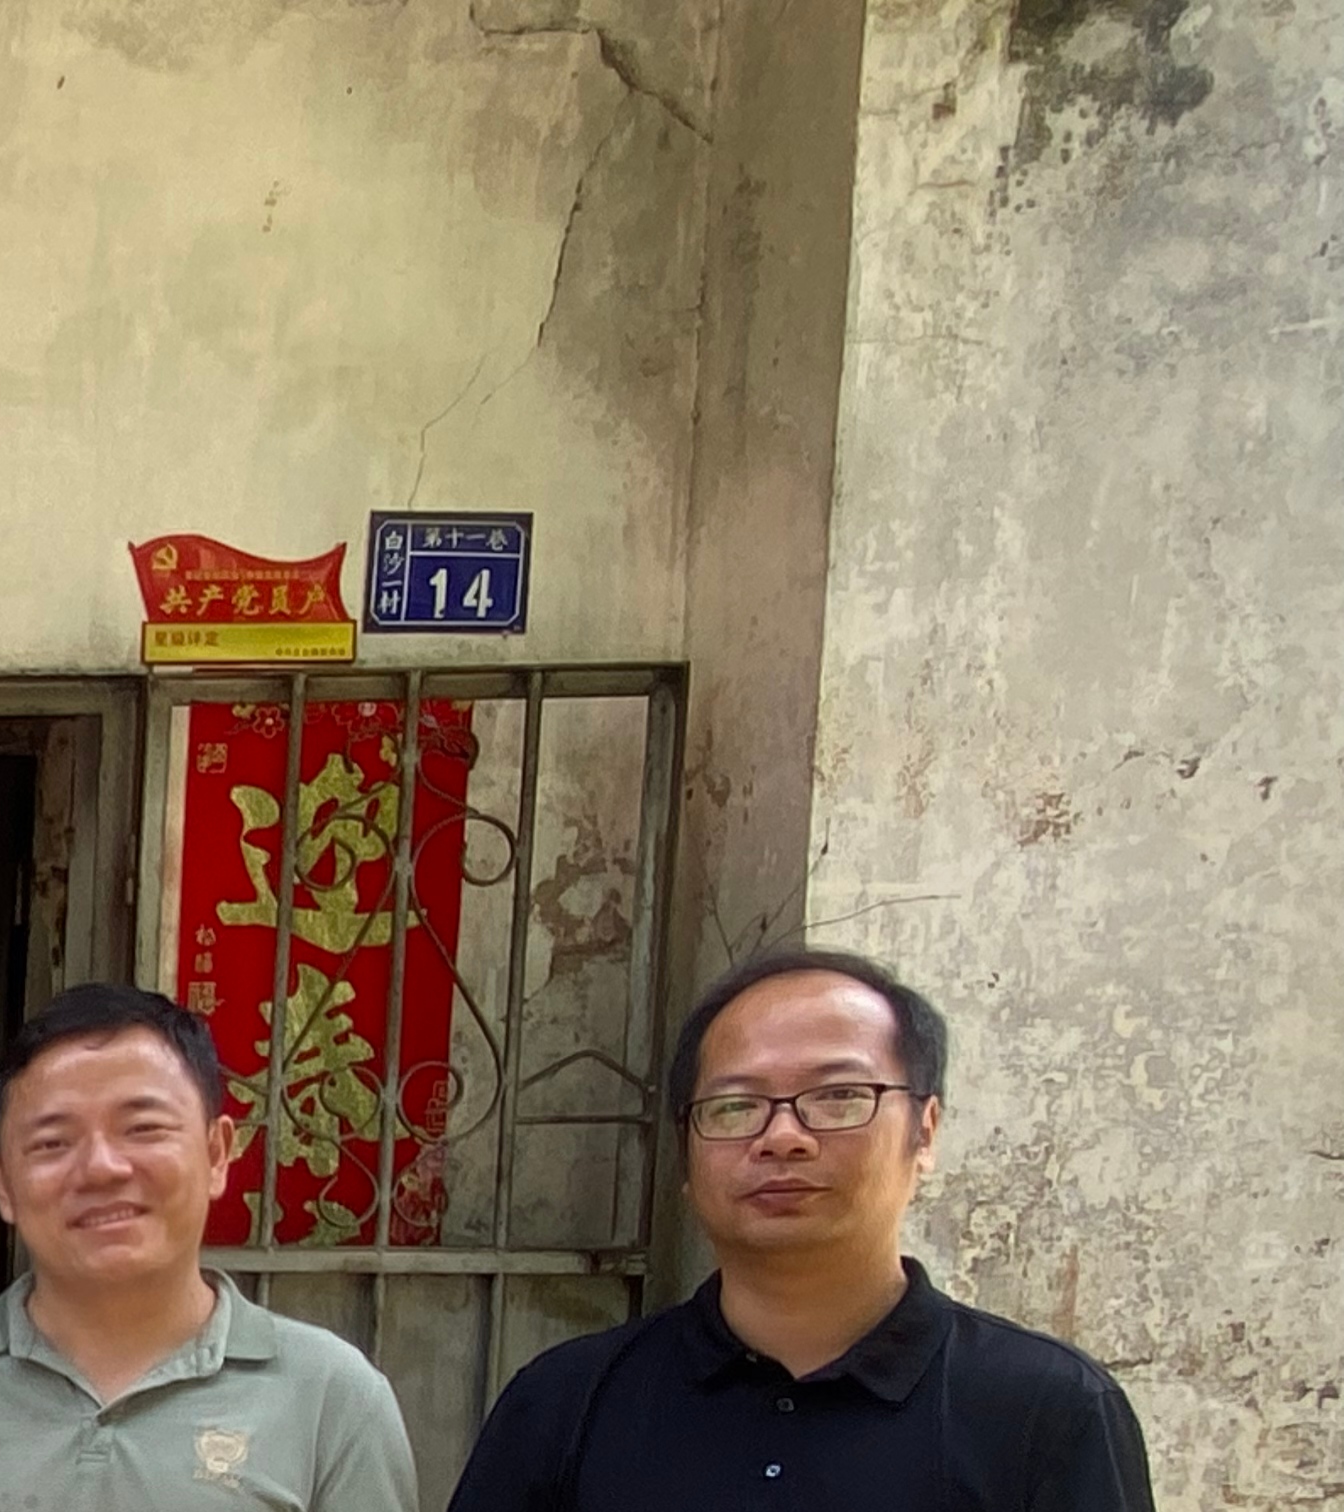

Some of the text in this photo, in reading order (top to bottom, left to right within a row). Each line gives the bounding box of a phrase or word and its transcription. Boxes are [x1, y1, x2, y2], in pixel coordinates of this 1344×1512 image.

[422, 527, 509, 551] 第十一巷
[429, 568, 494, 618] 14
